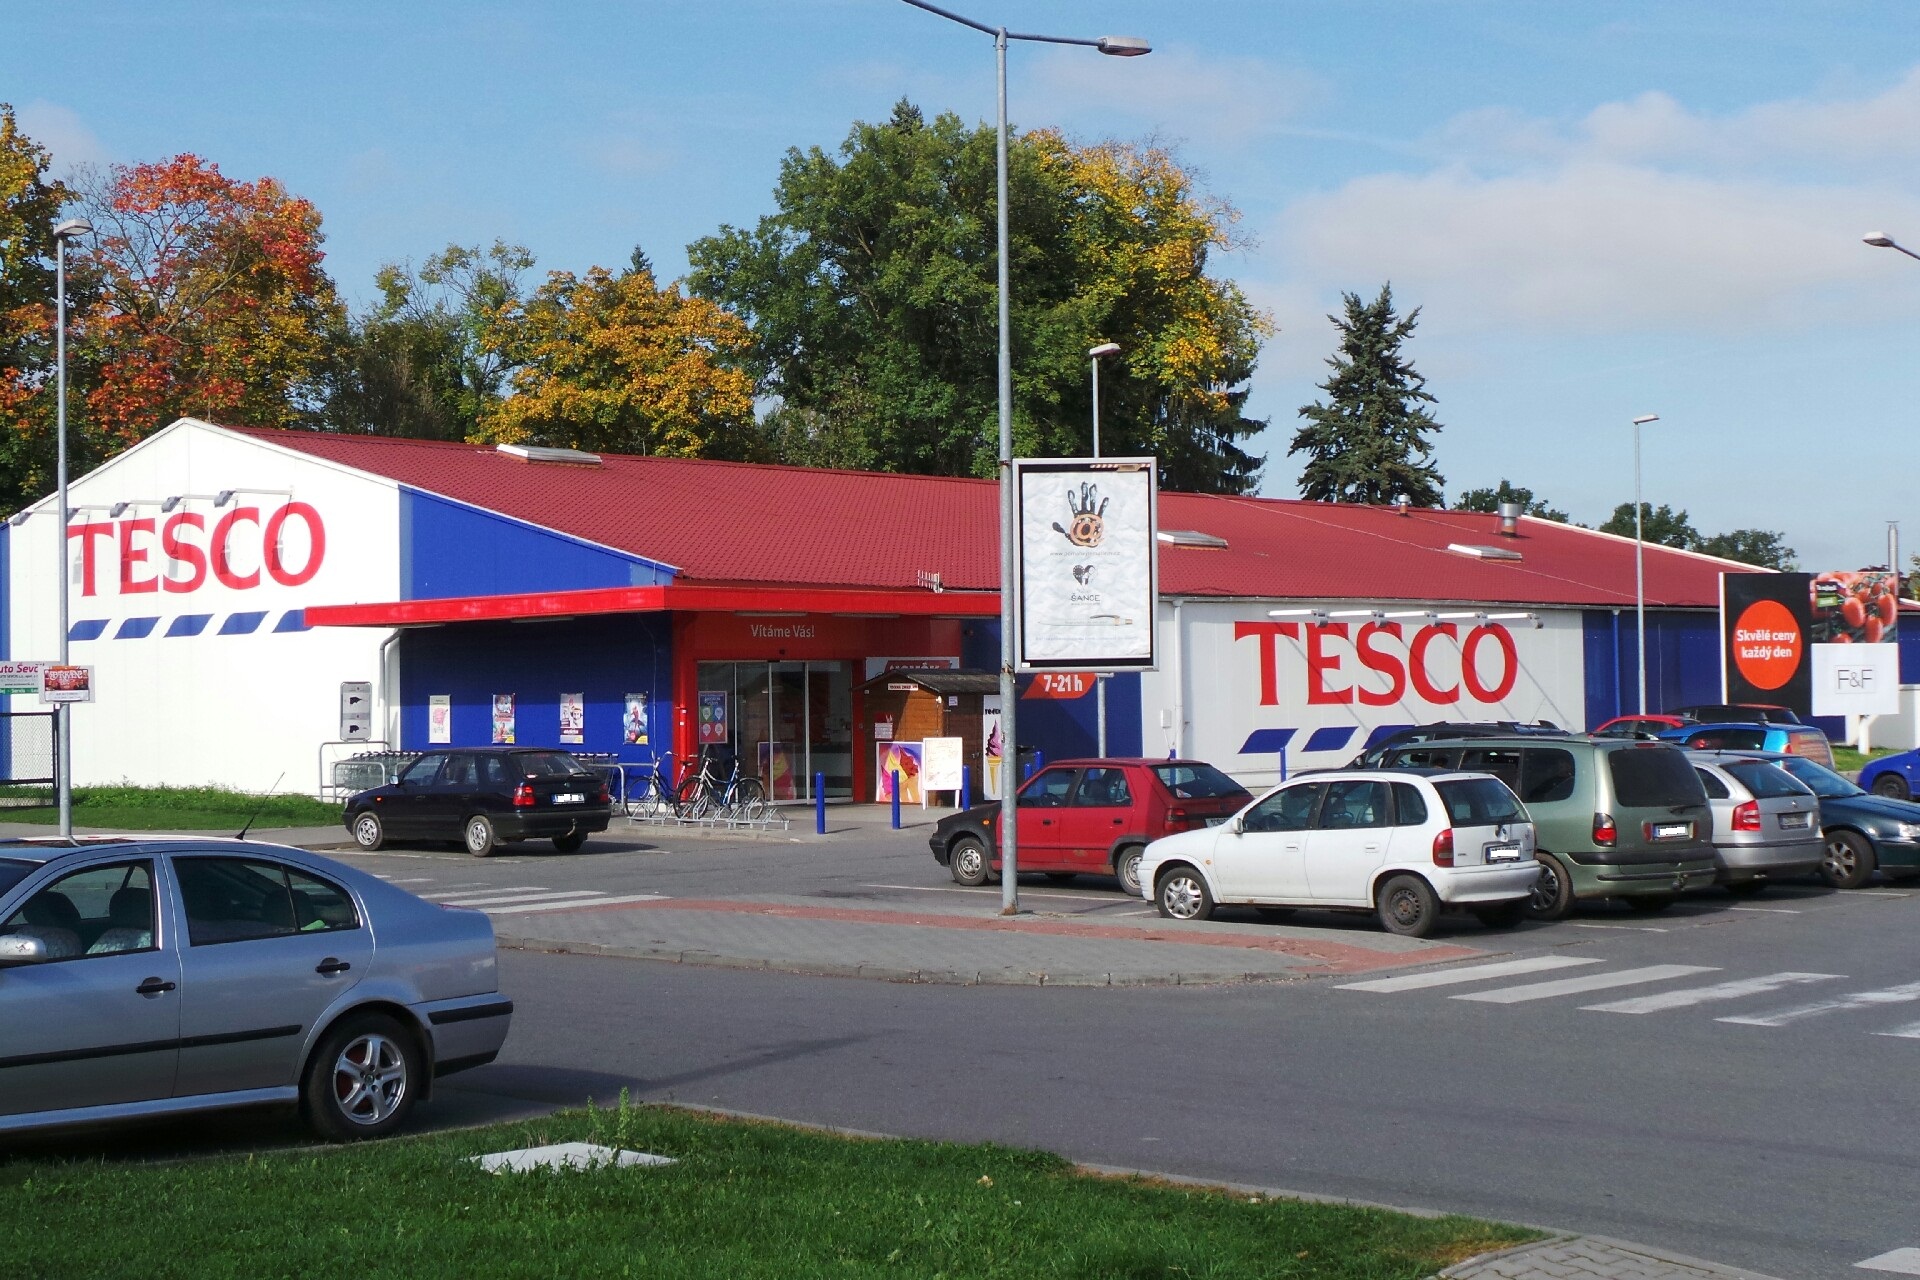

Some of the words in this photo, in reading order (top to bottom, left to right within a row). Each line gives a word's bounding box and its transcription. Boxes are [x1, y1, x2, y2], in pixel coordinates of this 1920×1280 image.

[67, 501, 326, 597] TESCO
[1070, 592, 1101, 602] ŠANCE
[750, 624, 791, 638] Vítáme
[793, 624, 815, 638] Vás!
[1736, 629, 1770, 642] Skvělé
[1772, 632, 1796, 643] ceny
[1741, 646, 1771, 660] každý
[1773, 647, 1792, 658] den
[1234, 621, 1518, 706] TESCO
[1043, 674, 1072, 692] 7-21
[1838, 669, 1873, 689] F&F
